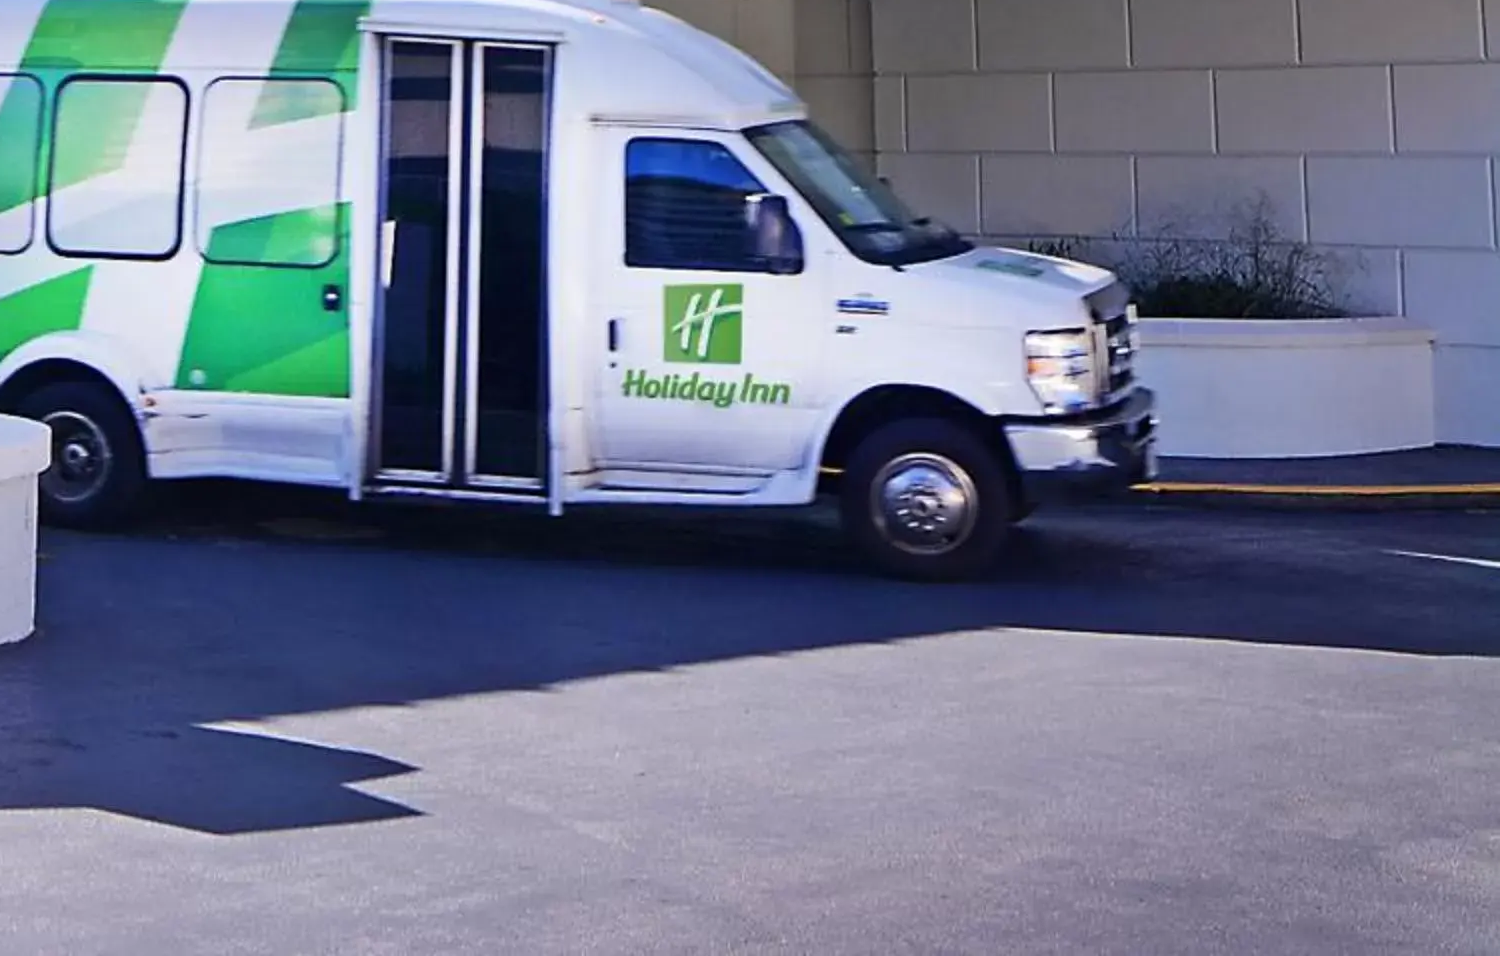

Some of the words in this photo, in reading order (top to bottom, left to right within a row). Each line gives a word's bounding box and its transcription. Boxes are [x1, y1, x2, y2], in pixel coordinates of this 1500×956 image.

[672, 288, 742, 358] H
[622, 369, 736, 408] Holiday
[740, 373, 790, 404] Inn
